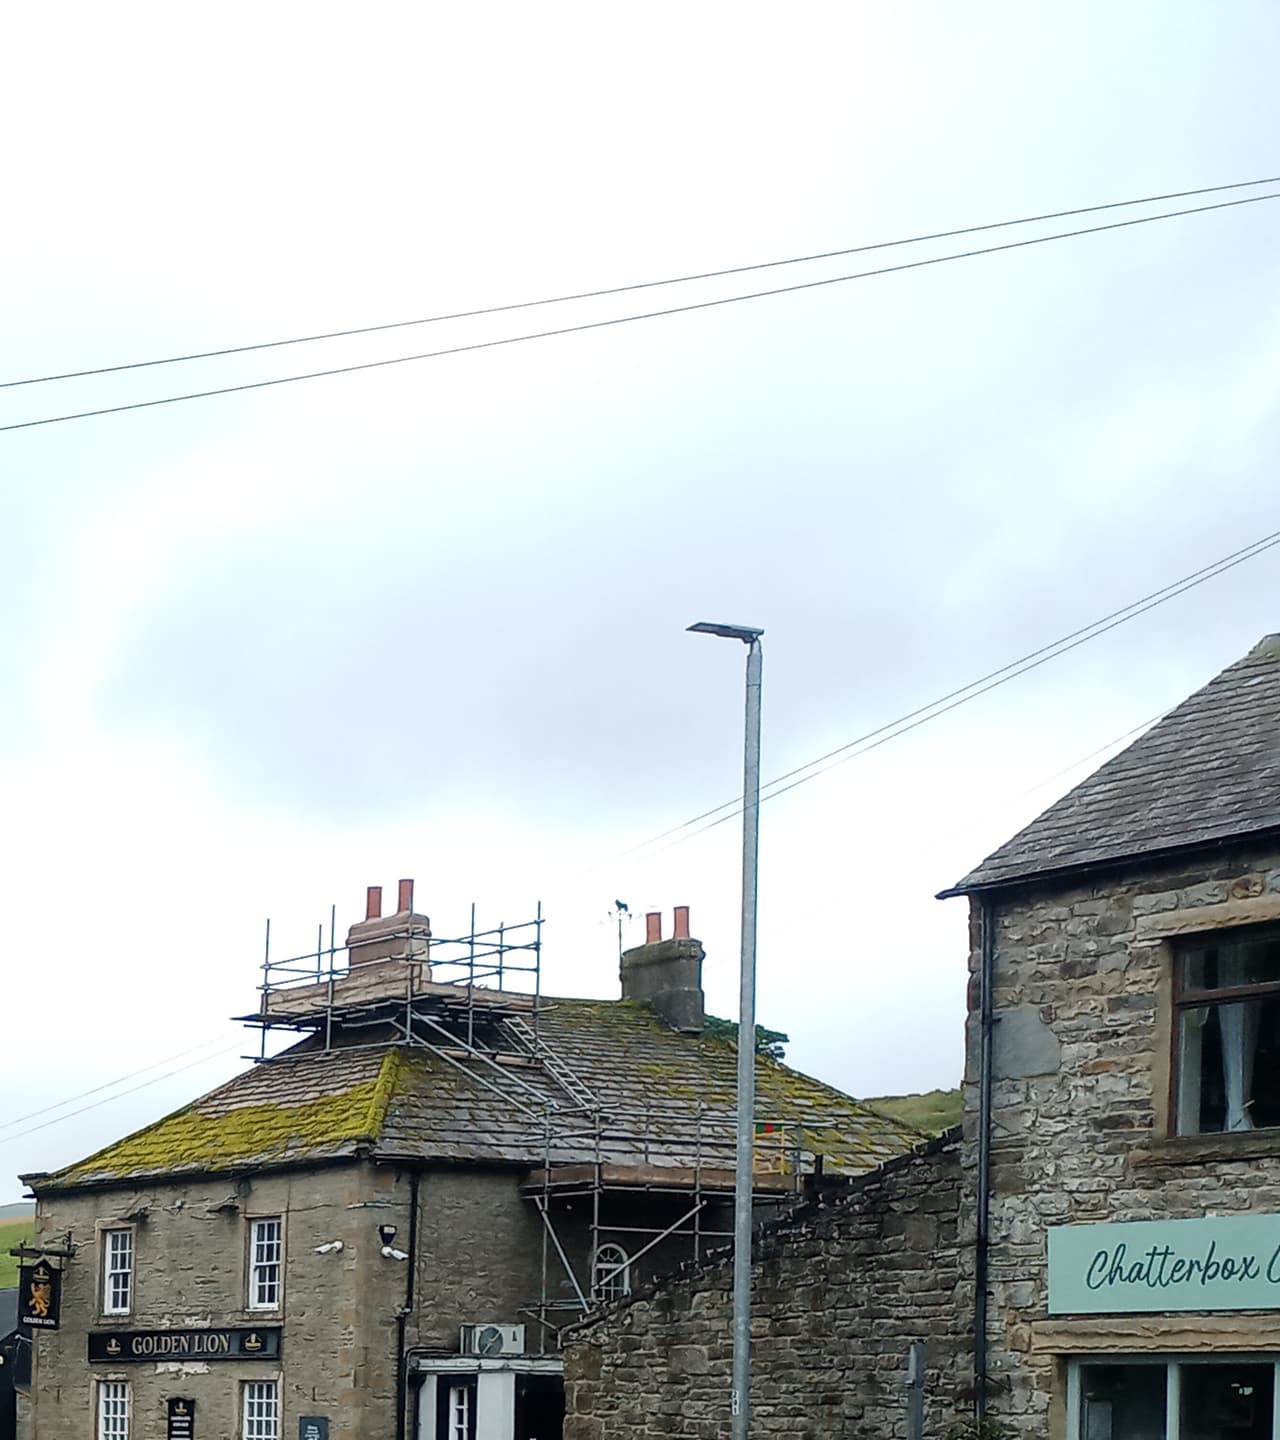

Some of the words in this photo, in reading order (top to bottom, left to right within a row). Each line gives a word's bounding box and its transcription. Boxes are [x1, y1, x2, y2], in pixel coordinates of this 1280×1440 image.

[1086, 1240, 1260, 1290] Chatterbox
[131, 1336, 190, 1355] GOLDEN
[194, 1334, 230, 1353] LION
